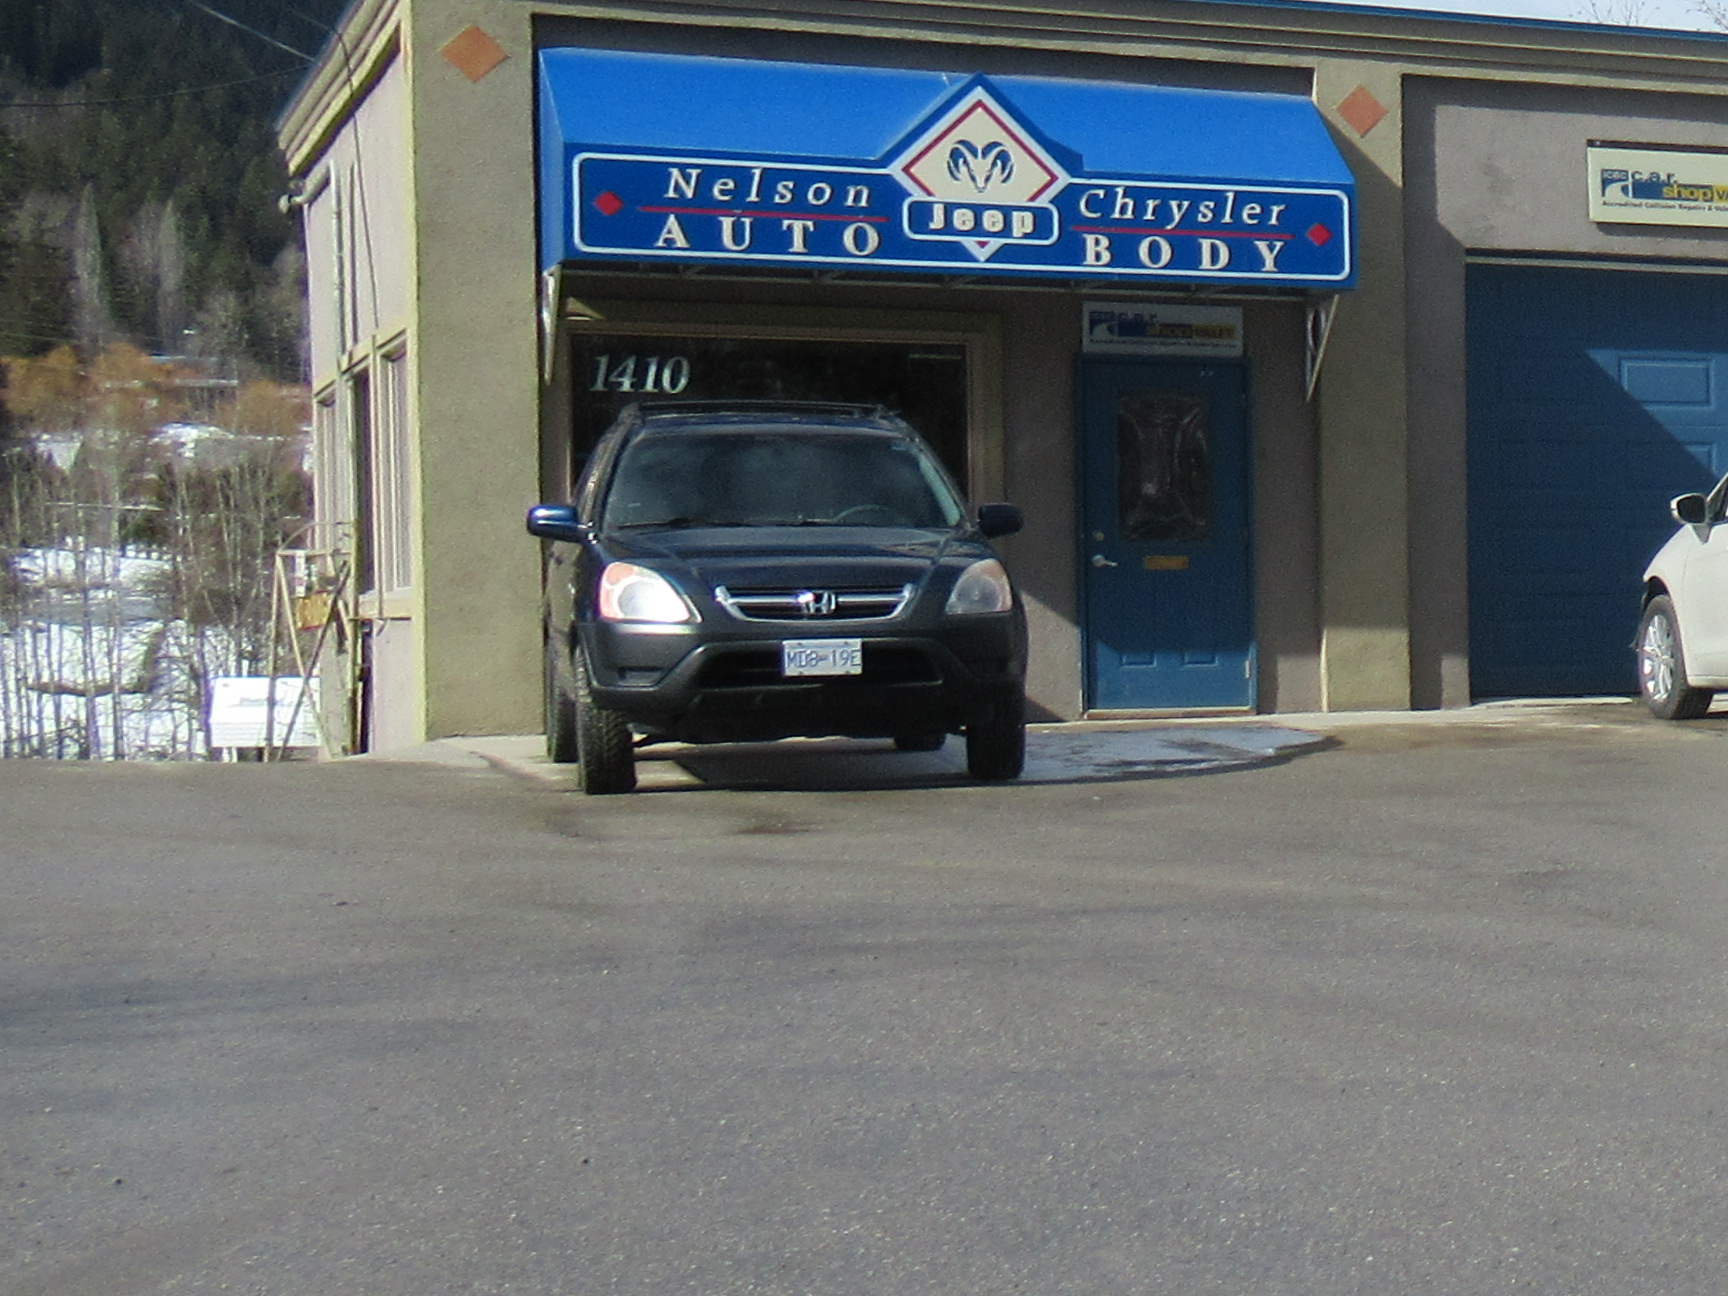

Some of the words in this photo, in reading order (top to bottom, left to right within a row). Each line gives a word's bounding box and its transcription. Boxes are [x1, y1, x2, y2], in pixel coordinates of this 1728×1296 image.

[664, 167, 871, 207] Nelson
[1662, 182, 1714, 202] shop
[928, 202, 1035, 238] Jeep
[1079, 186, 1287, 230] Chrysler
[654, 213, 880, 256] AUTO
[1082, 233, 1285, 273] BODY
[589, 354, 690, 394] 1410
